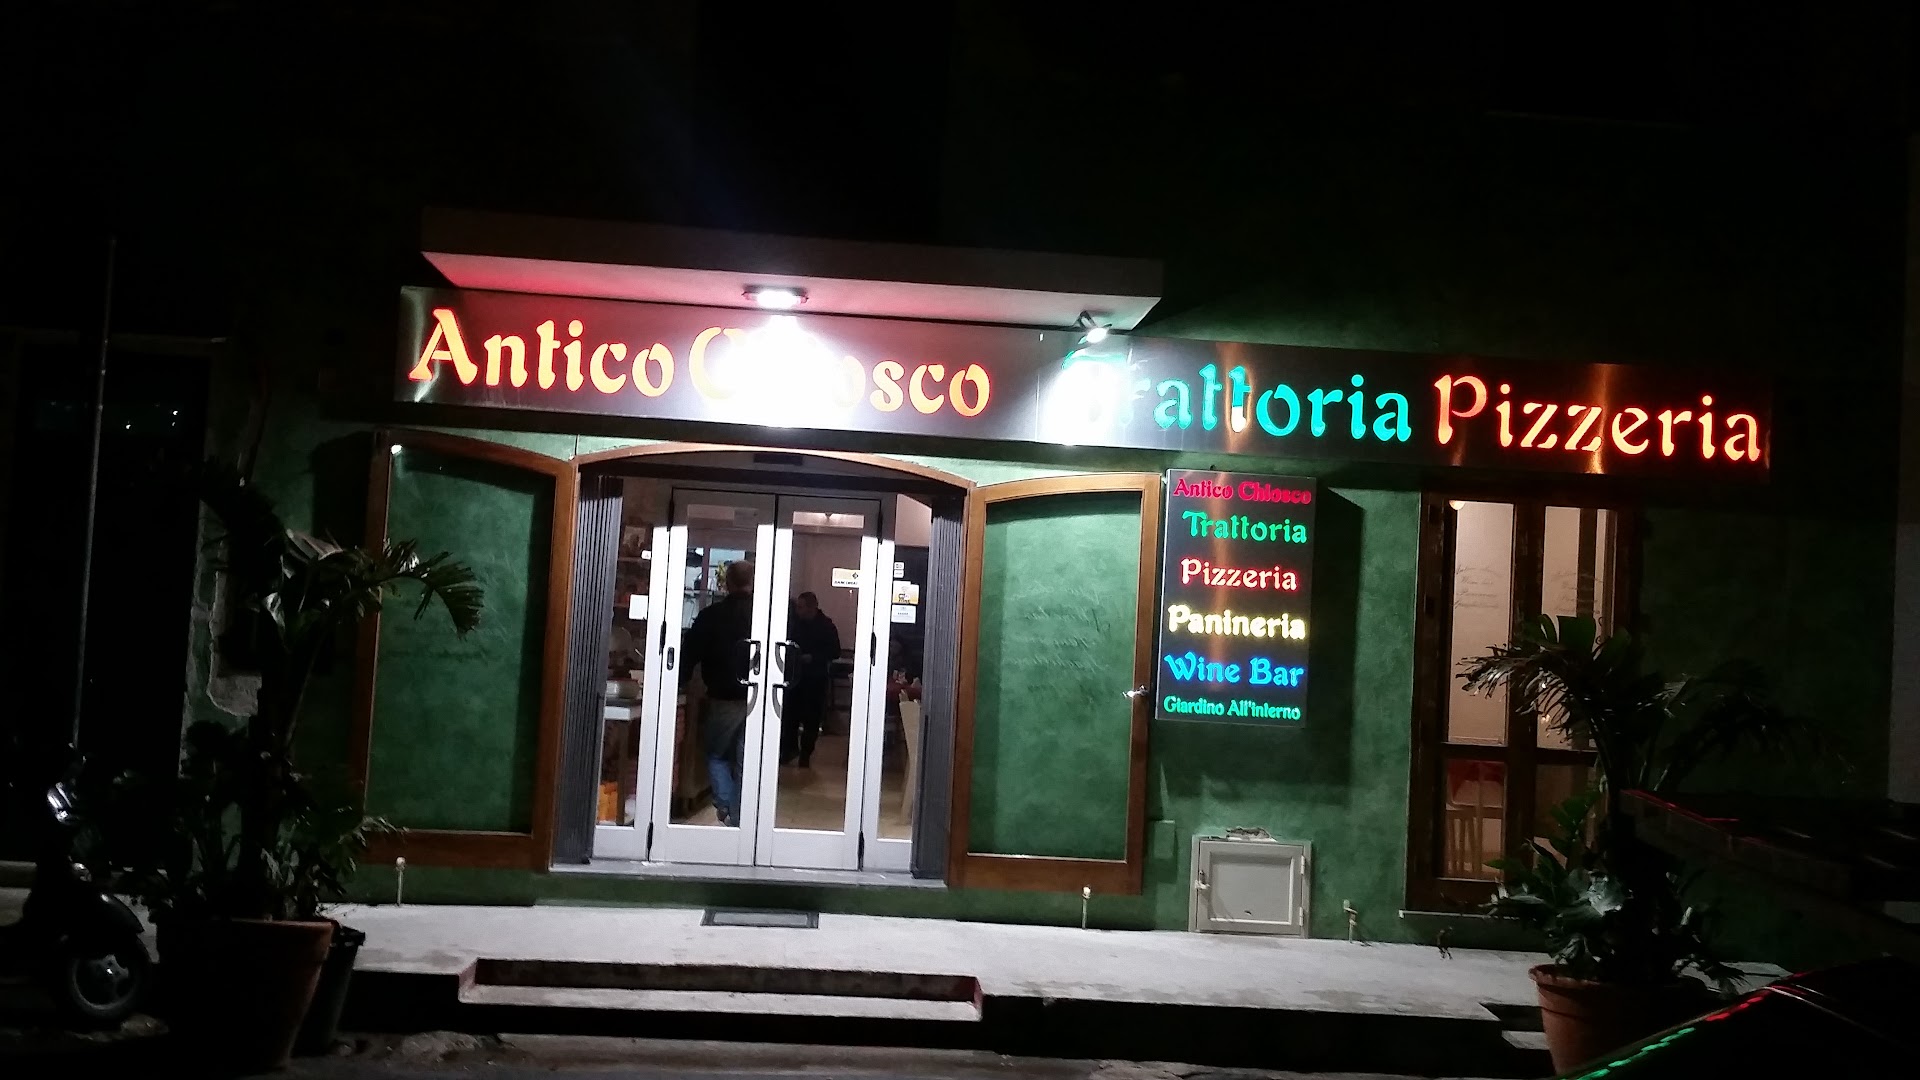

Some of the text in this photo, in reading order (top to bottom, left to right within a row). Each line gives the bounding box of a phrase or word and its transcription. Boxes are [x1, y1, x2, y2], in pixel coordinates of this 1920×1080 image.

[408, 308, 676, 398] Antico
[688, 326, 991, 418] Cosco
[1434, 374, 1761, 462] Pizzeria
[1173, 478, 1312, 505] Antico Chiosco
[1182, 510, 1308, 544] Trattoria
[1180, 557, 1298, 591] Pizzeria
[1167, 604, 1306, 640] Panineria
[1164, 651, 1305, 687] Wine Bar
[1163, 695, 1224, 716] Giardino
